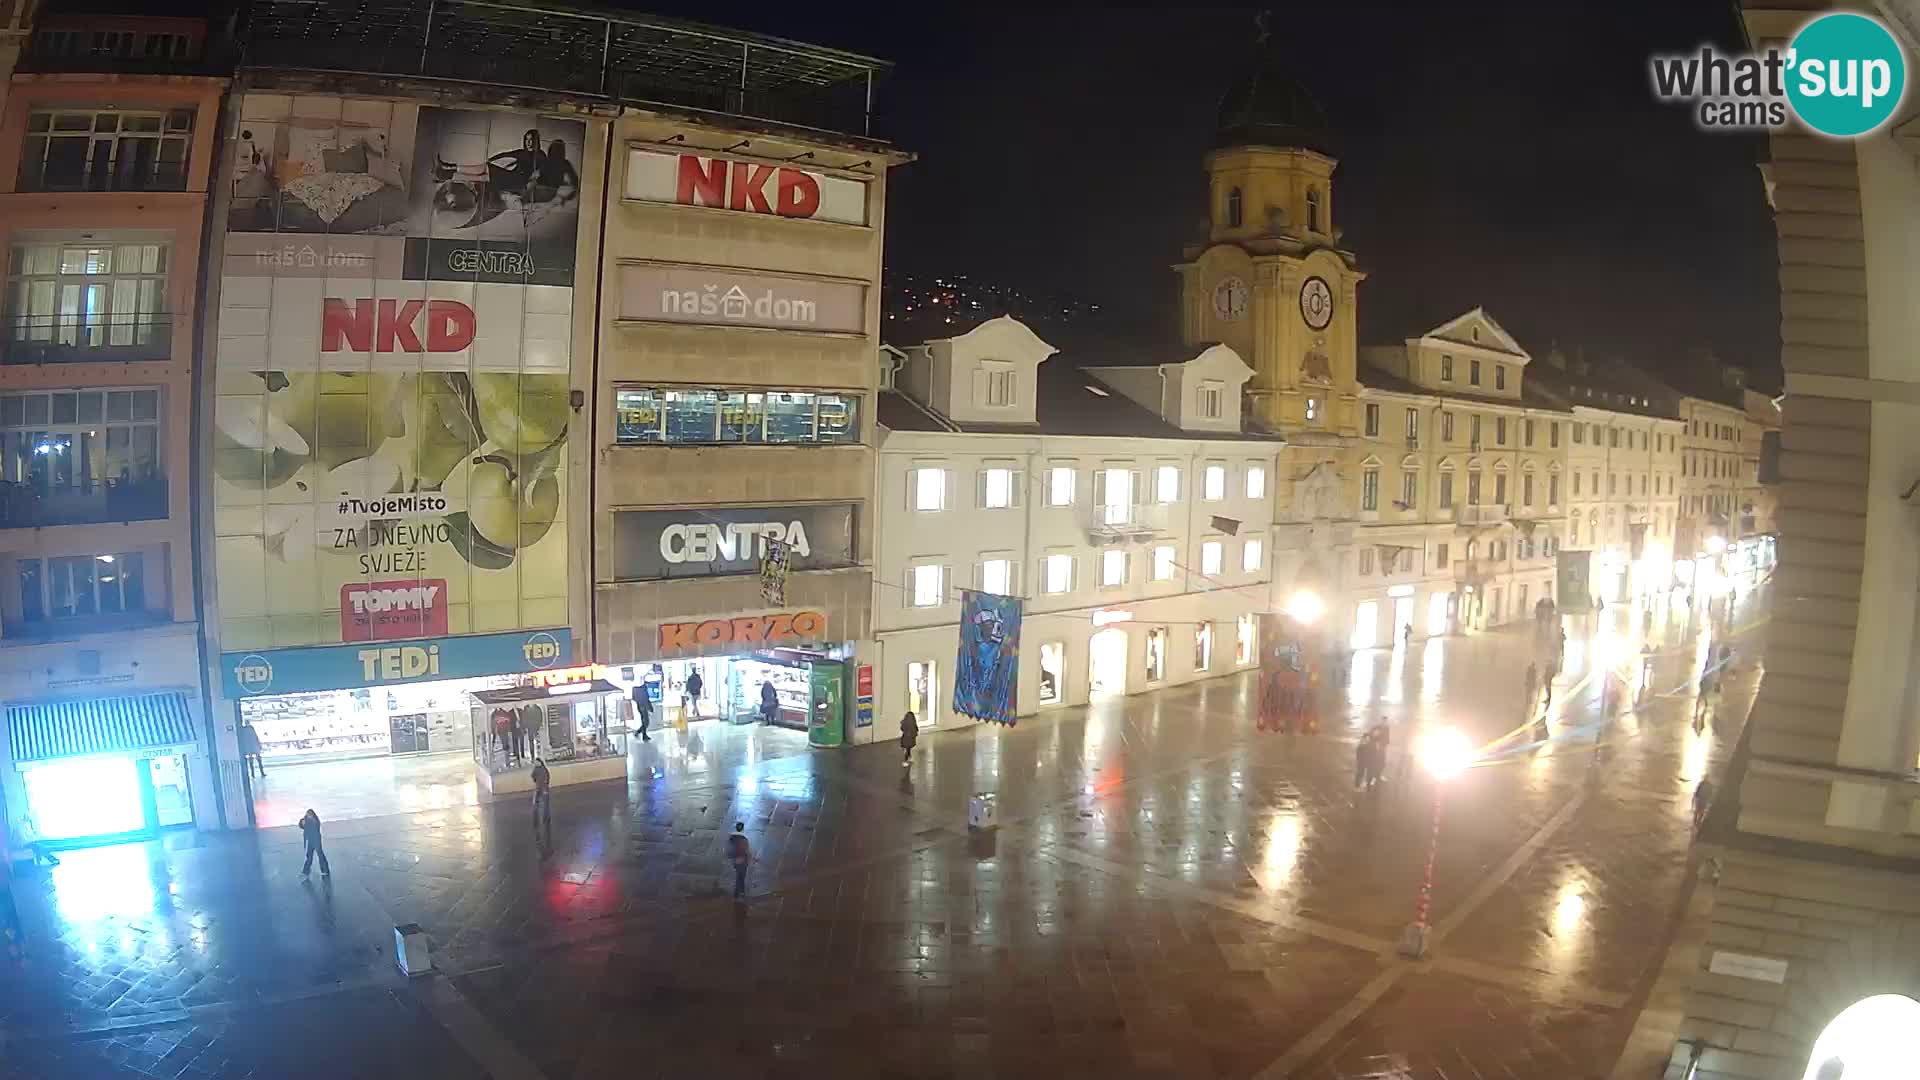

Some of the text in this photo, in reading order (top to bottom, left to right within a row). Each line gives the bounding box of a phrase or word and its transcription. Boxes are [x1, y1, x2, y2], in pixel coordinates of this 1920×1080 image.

[676, 154, 820, 218] NKD
[449, 249, 535, 275] CENTRA
[662, 284, 816, 322] naš dom
[321, 297, 476, 353] NKD
[339, 496, 446, 515] #TvojeMisto
[334, 523, 450, 549] ZA DNEVNO
[660, 521, 810, 563] CENTRA
[359, 547, 426, 574] SVJEŽE
[349, 586, 439, 613] TOMMY
[659, 612, 826, 649] KORZO
[358, 645, 439, 681] TEDi
